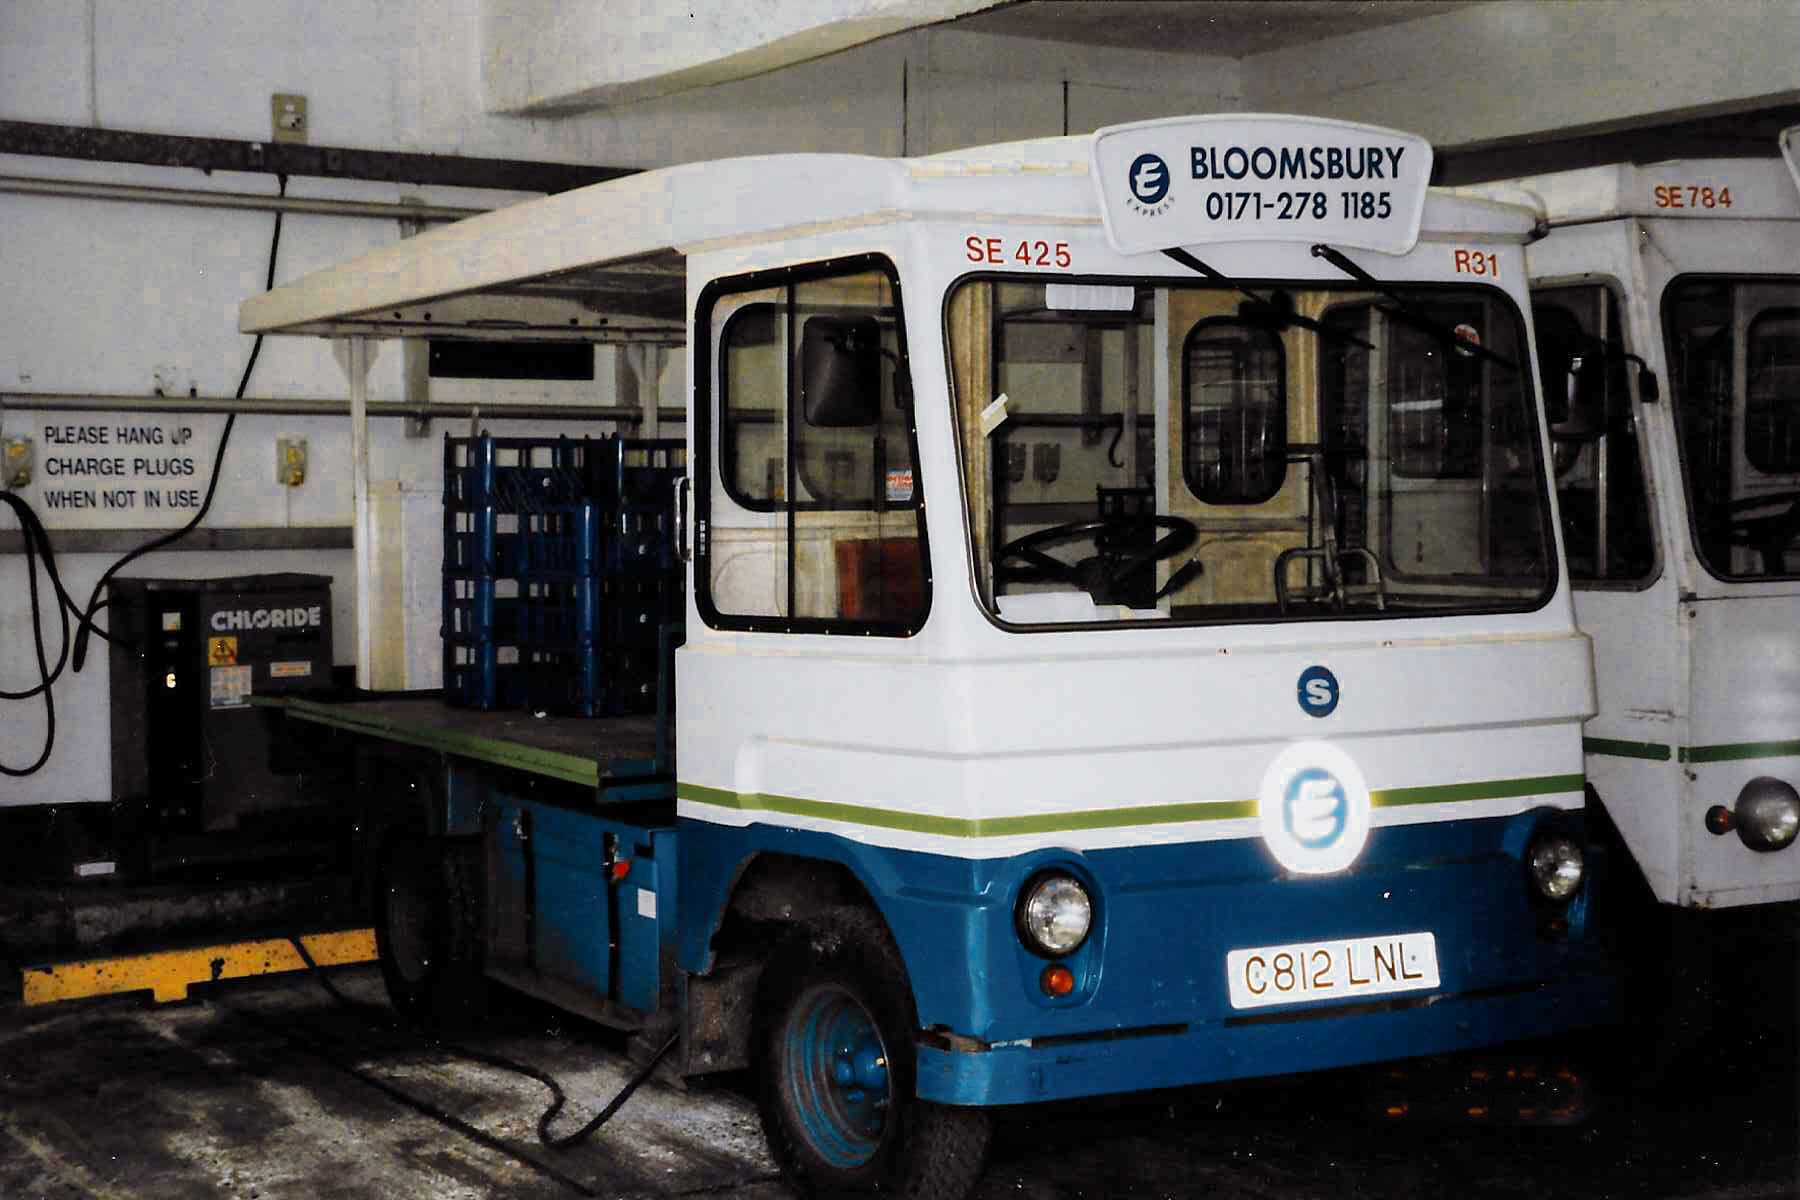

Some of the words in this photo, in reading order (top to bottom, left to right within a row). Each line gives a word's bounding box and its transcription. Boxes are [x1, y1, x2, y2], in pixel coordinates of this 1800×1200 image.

[1191, 147, 1405, 180] BLOOMSBURY
[1206, 192, 1327, 220] 0171-278
[1342, 192, 1392, 220] 1185
[966, 236, 1004, 263] SE
[1015, 240, 1071, 268] 425
[1455, 250, 1497, 276] R31
[45, 426, 108, 444] PLEASE
[117, 427, 163, 444] HANG
[171, 427, 192, 445] UP
[46, 458, 125, 475] CHARGE
[134, 458, 194, 475] PLUGS
[45, 491, 96, 508] WHEN
[104, 491, 136, 508] NOT
[144, 491, 160, 508] IN
[168, 490, 200, 507] USE
[210, 606, 321, 631] CHLORIDE
[1245, 950, 1334, 995] C812
[1346, 942, 1424, 985] LNL
